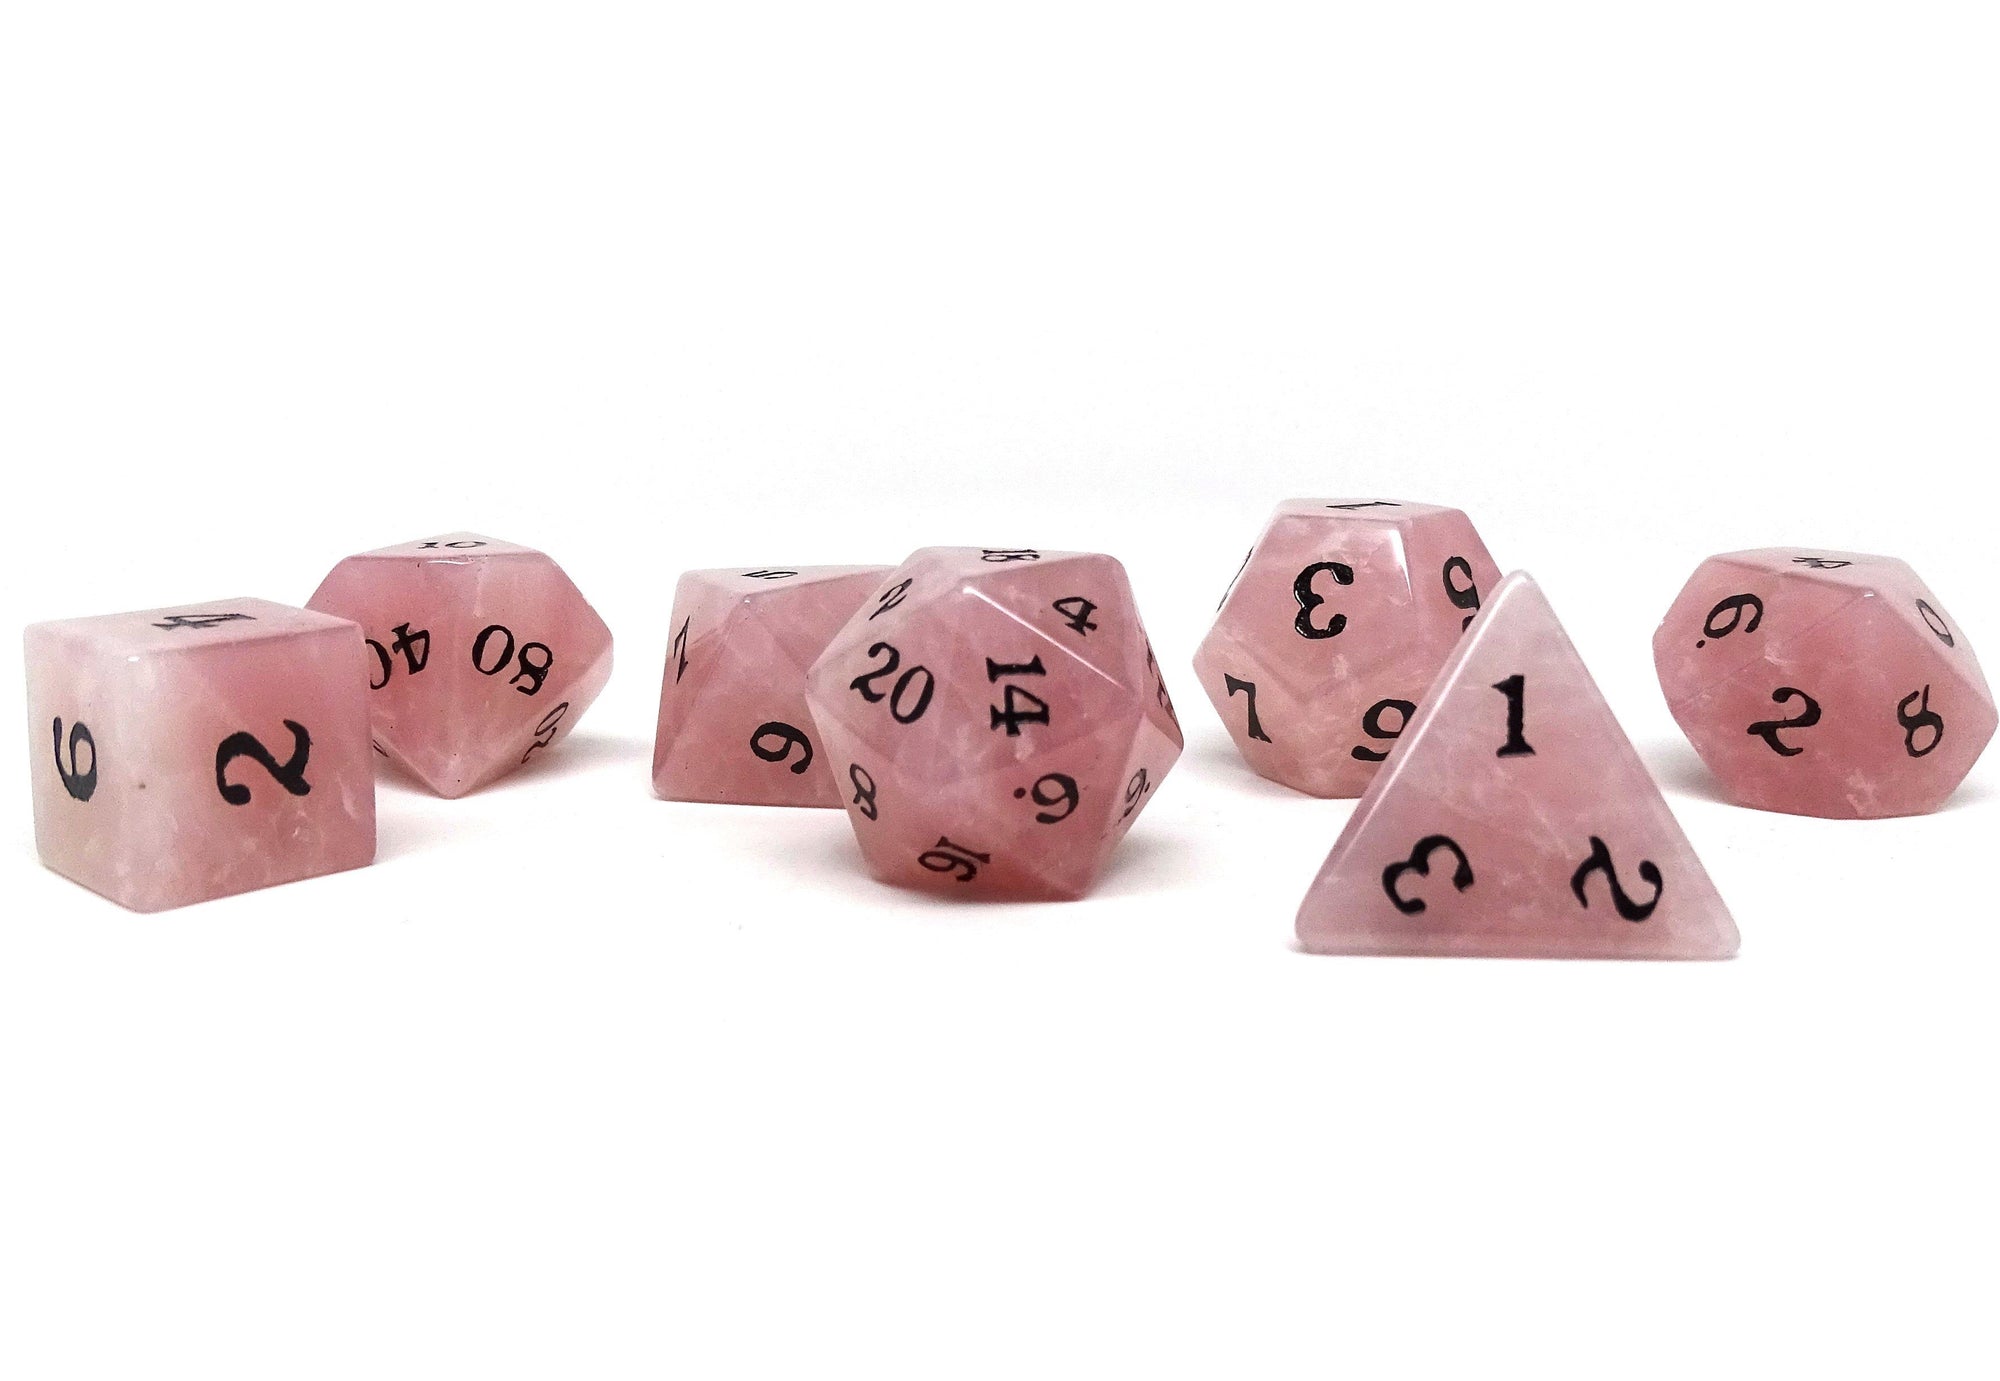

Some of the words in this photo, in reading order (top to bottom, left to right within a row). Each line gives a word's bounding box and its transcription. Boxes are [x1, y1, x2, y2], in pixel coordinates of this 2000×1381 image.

[153, 613, 257, 631] 4
[1052, 596, 1098, 637] 4
[1293, 561, 1354, 640] 3
[1914, 598, 1955, 648] 0
[850, 642, 936, 725] 20
[986, 654, 1051, 738] 14
[1223, 672, 1273, 744] 7
[1491, 674, 1536, 759] 1
[1746, 686, 1823, 758] 2
[1896, 684, 1945, 759] 8
[215, 718, 314, 807] 2
[850, 763, 878, 822] 8
[1381, 834, 1475, 917] 3
[1569, 835, 1664, 924] 2
